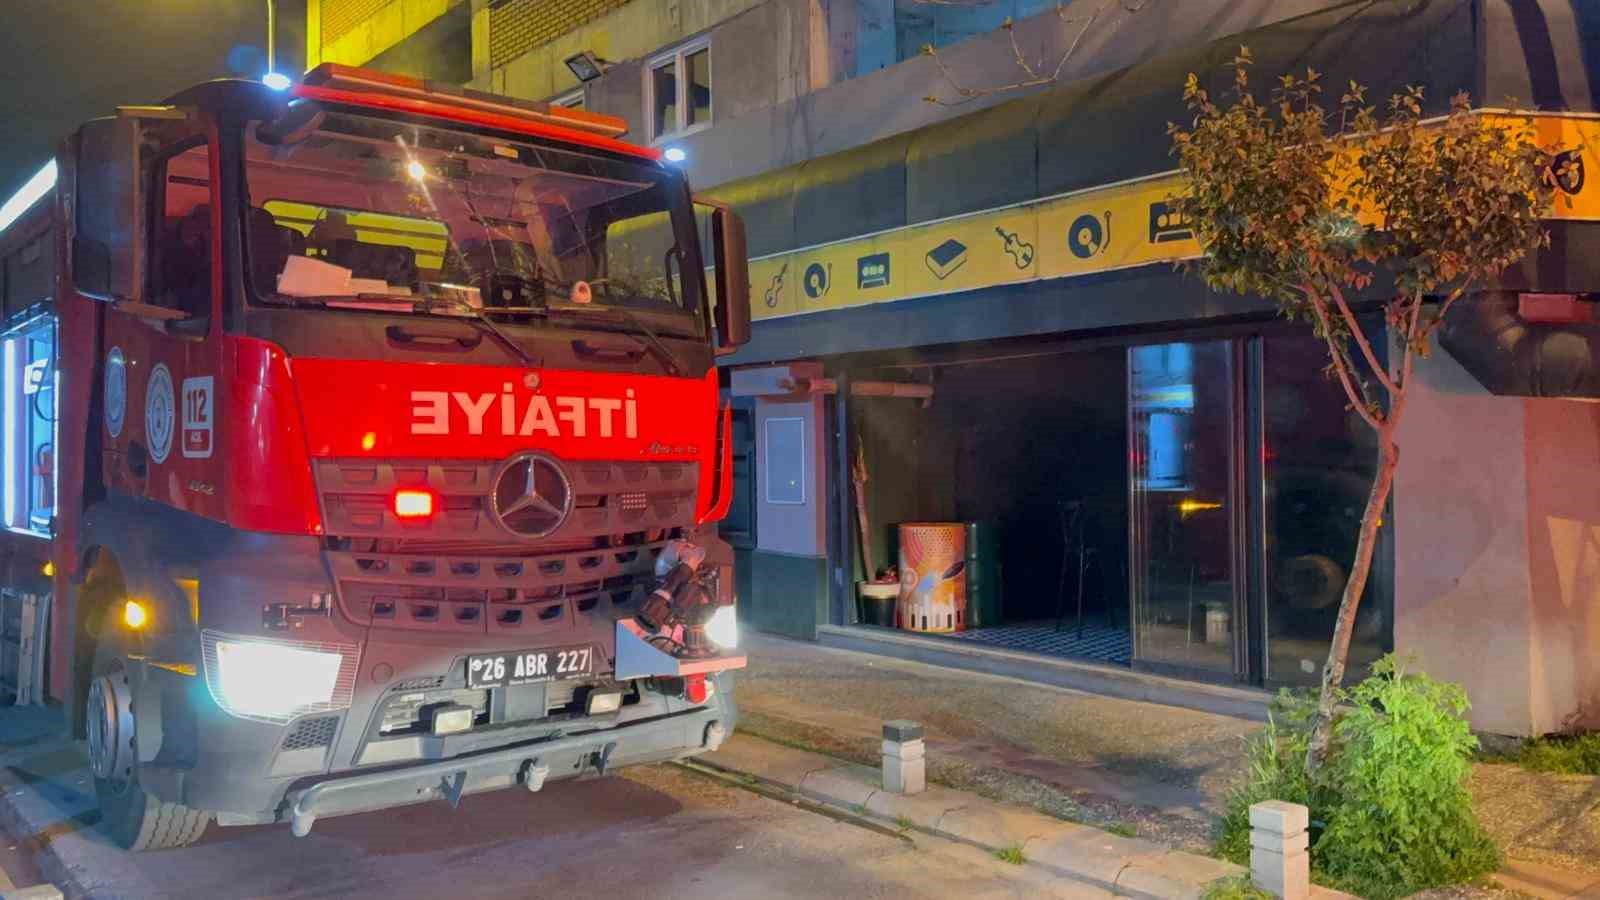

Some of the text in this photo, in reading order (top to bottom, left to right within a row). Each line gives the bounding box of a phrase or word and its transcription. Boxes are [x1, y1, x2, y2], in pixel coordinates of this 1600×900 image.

[187, 389, 208, 424] 112
[482, 657, 505, 681] 26
[514, 653, 548, 677] ABR
[556, 649, 589, 673] 227
